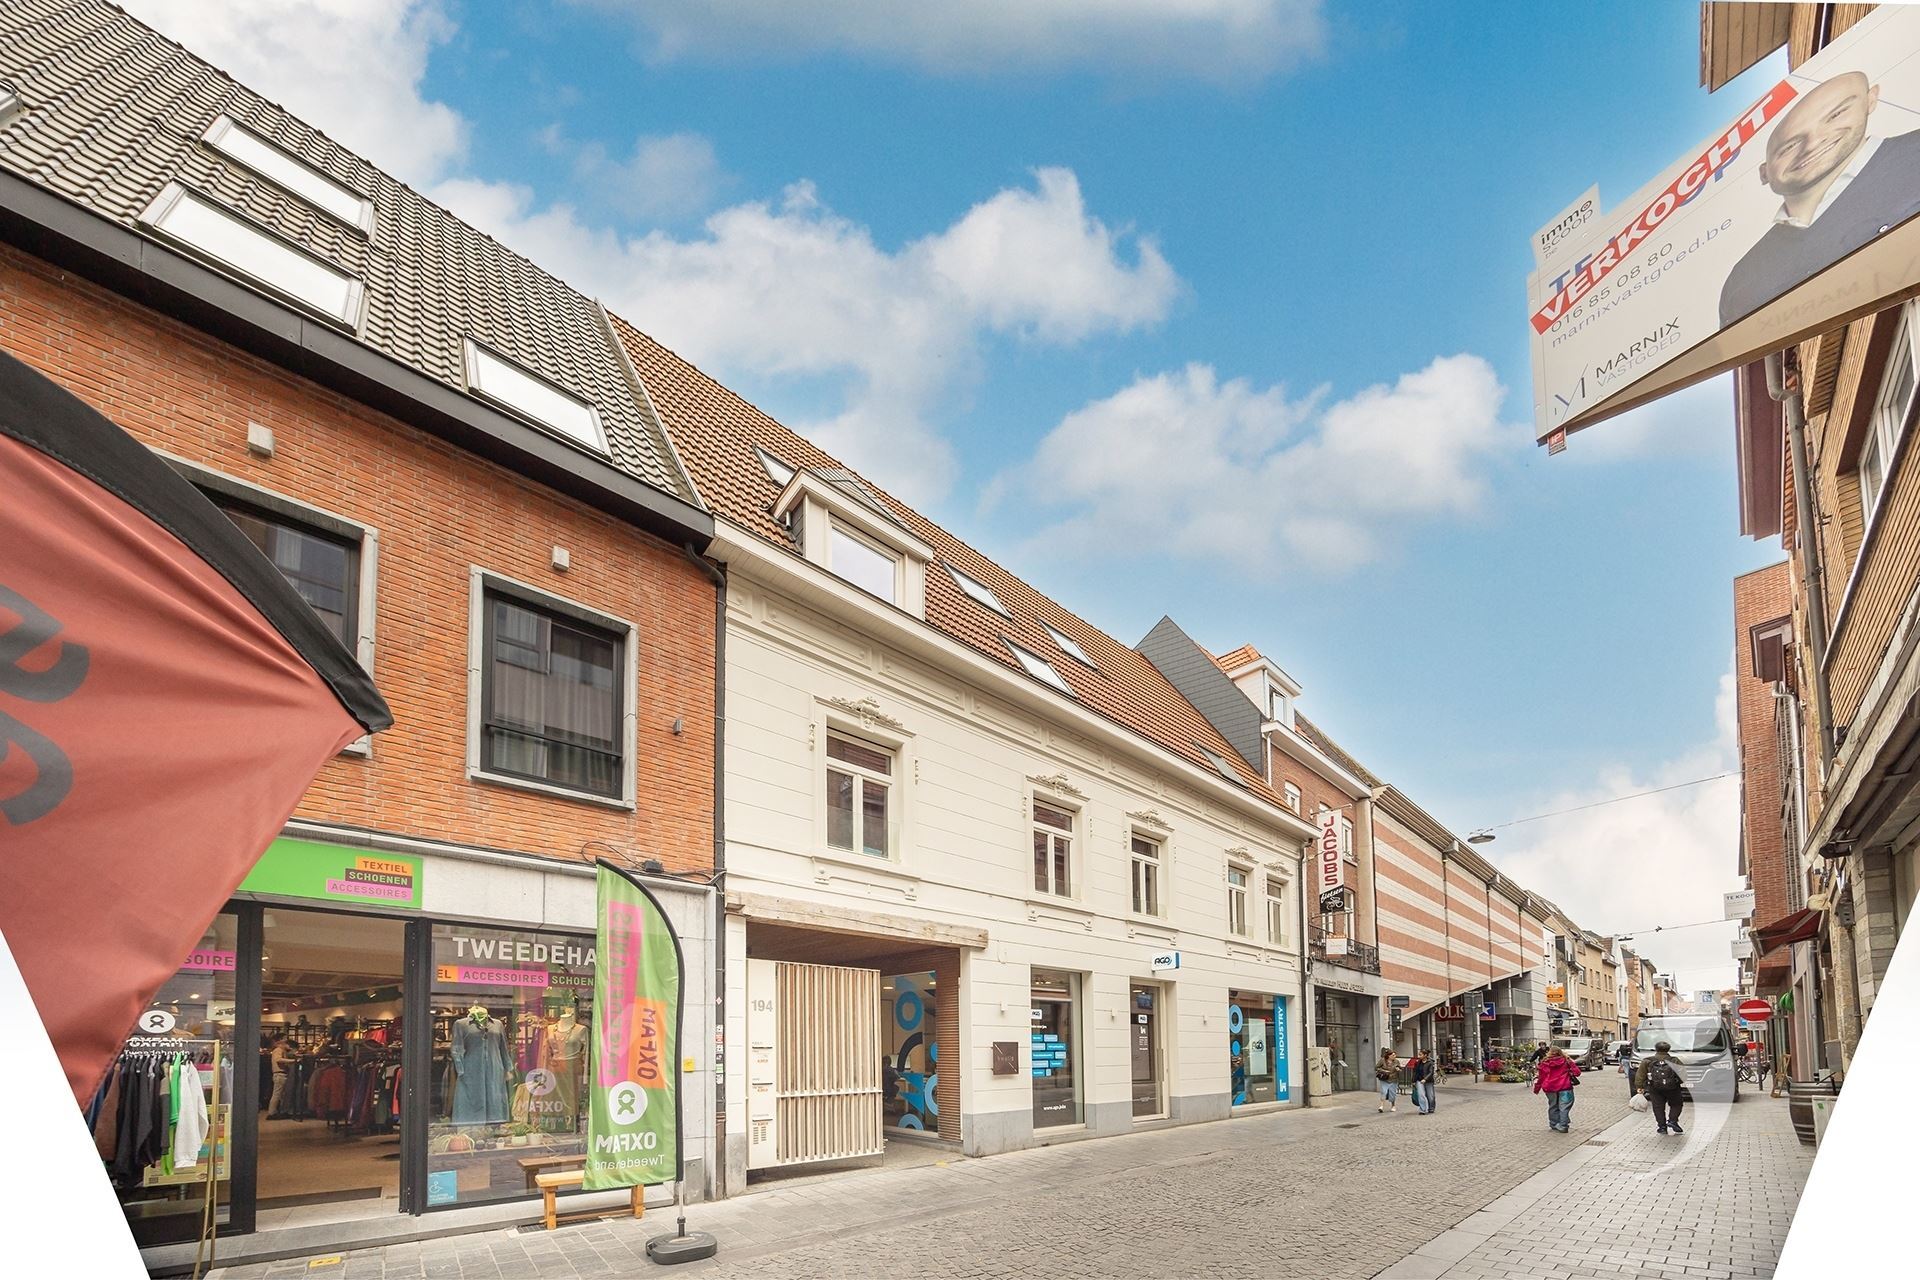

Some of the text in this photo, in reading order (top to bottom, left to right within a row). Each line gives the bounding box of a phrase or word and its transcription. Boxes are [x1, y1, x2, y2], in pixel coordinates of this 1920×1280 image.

[1540, 95, 1774, 321] VERKOCHT
[1541, 200, 1592, 244] immo
[1543, 209, 1593, 252] scoop
[1551, 243, 1672, 333] 016 85 08 80
[1552, 217, 1732, 348] marnixvastgoed.be
[1596, 317, 1680, 378] MARNIX
[1597, 332, 1681, 387] VASTGOED
[363, 860, 408, 874] TEXTIEL
[1323, 815, 1338, 886] JACOBS
[331, 882, 408, 898] ACCESSOIRES
[349, 871, 408, 886] SCHOENEN
[452, 937, 597, 966] TWEEDEHA
[463, 971, 544, 984] ACCESSOIRES
[551, 975, 594, 986] SCHOEN
[751, 1000, 773, 1012] 194
